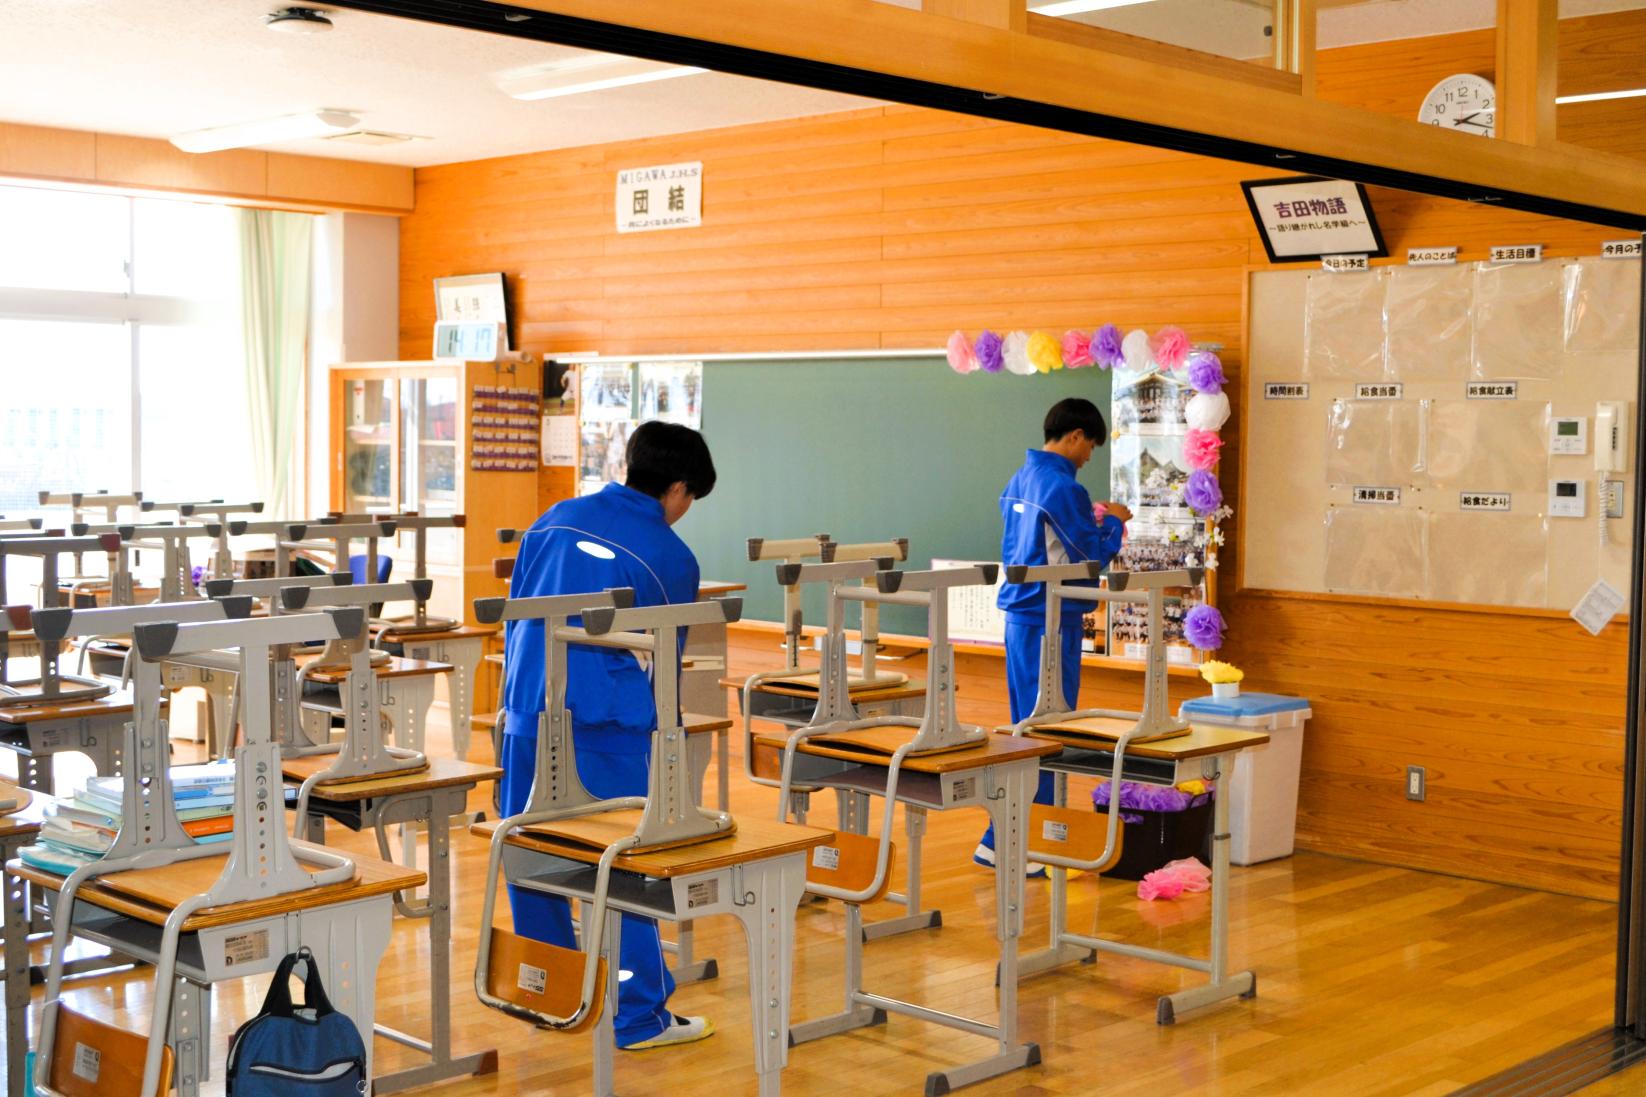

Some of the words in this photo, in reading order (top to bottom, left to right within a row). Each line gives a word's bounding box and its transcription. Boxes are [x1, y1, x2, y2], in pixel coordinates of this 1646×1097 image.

[1445, 92, 1453, 102] 11
[1457, 86, 1468, 97] 12
[1474, 89, 1478, 99] 1
[1435, 103, 1446, 114] 10
[1482, 99, 1490, 109] 2
[1486, 113, 1494, 124] 3
[620, 169, 667, 185] MIGAWA
[1273, 197, 1348, 218] 吉田物語
[1496, 248, 1536, 260] 生活目標
[1270, 386, 1304, 396] 時間割表
[1360, 386, 1397, 397] 給食当番
[1469, 386, 1514, 396] 給食献立表
[1358, 489, 1395, 501] 清掃当番
[1463, 497, 1507, 507] 給食だより
